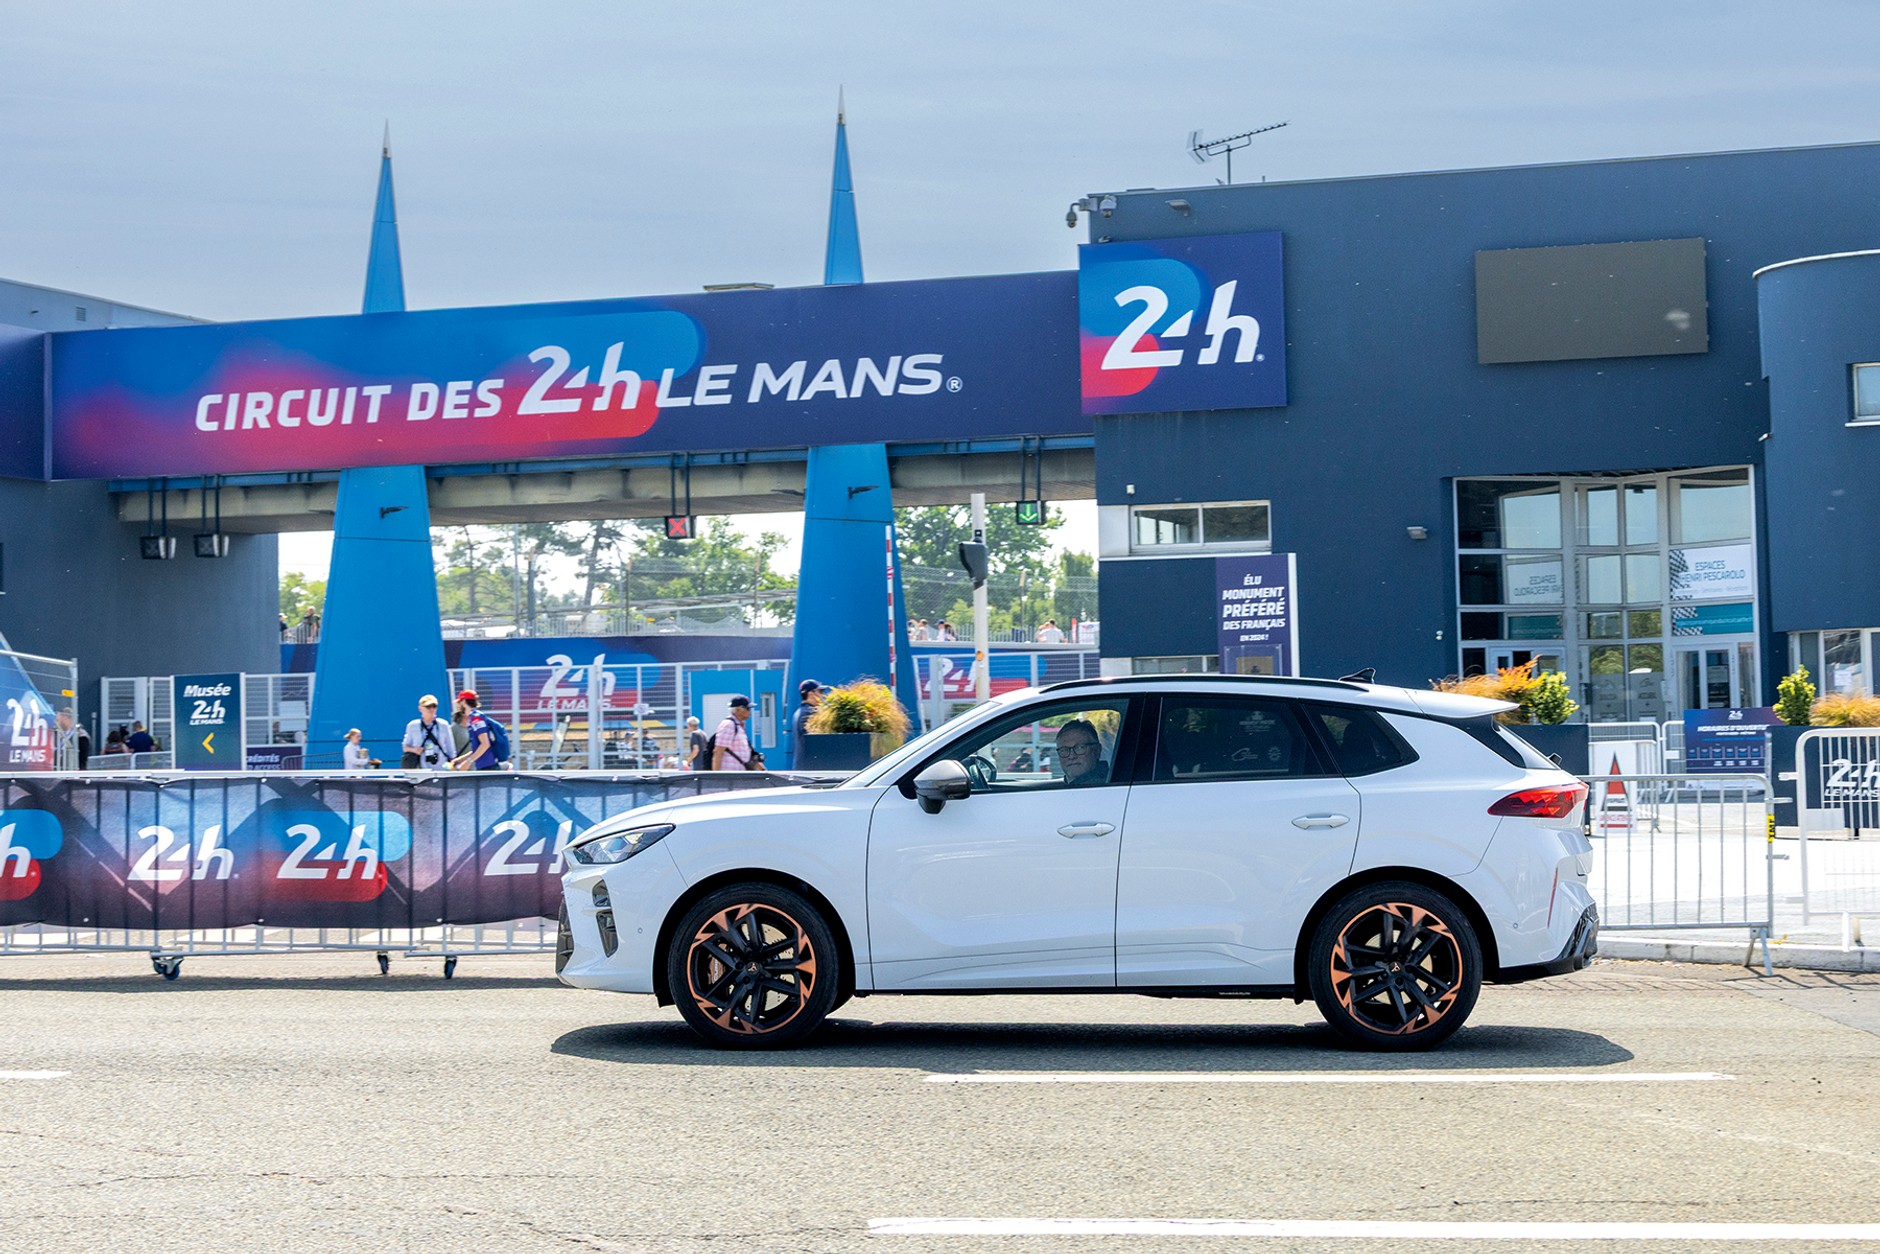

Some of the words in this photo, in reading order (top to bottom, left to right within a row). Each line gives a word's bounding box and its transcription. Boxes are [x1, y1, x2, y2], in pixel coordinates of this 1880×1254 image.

[195, 384, 392, 432] CIRCUIT
[406, 379, 505, 422] DES
[516, 341, 642, 415] 24h
[655, 364, 738, 408] LE
[1695, 560, 1726, 571] ESPACES
[1243, 573, 1262, 586] ÉLU
[1703, 569, 1746, 581] PESCAROLO
[1222, 586, 1285, 600] MONUMENT
[1222, 597, 1286, 618] PRÉFÉRÉ
[1222, 620, 1241, 631] DES
[1241, 618, 1286, 631] FRANÇAIS
[183, 683, 232, 697] Musée
[190, 700, 226, 719] 24h
[561, 699, 612, 710] MAS
[6, 698, 48, 747] 24h
[1824, 788, 1842, 797] LE
[276, 823, 379, 880] 24h
